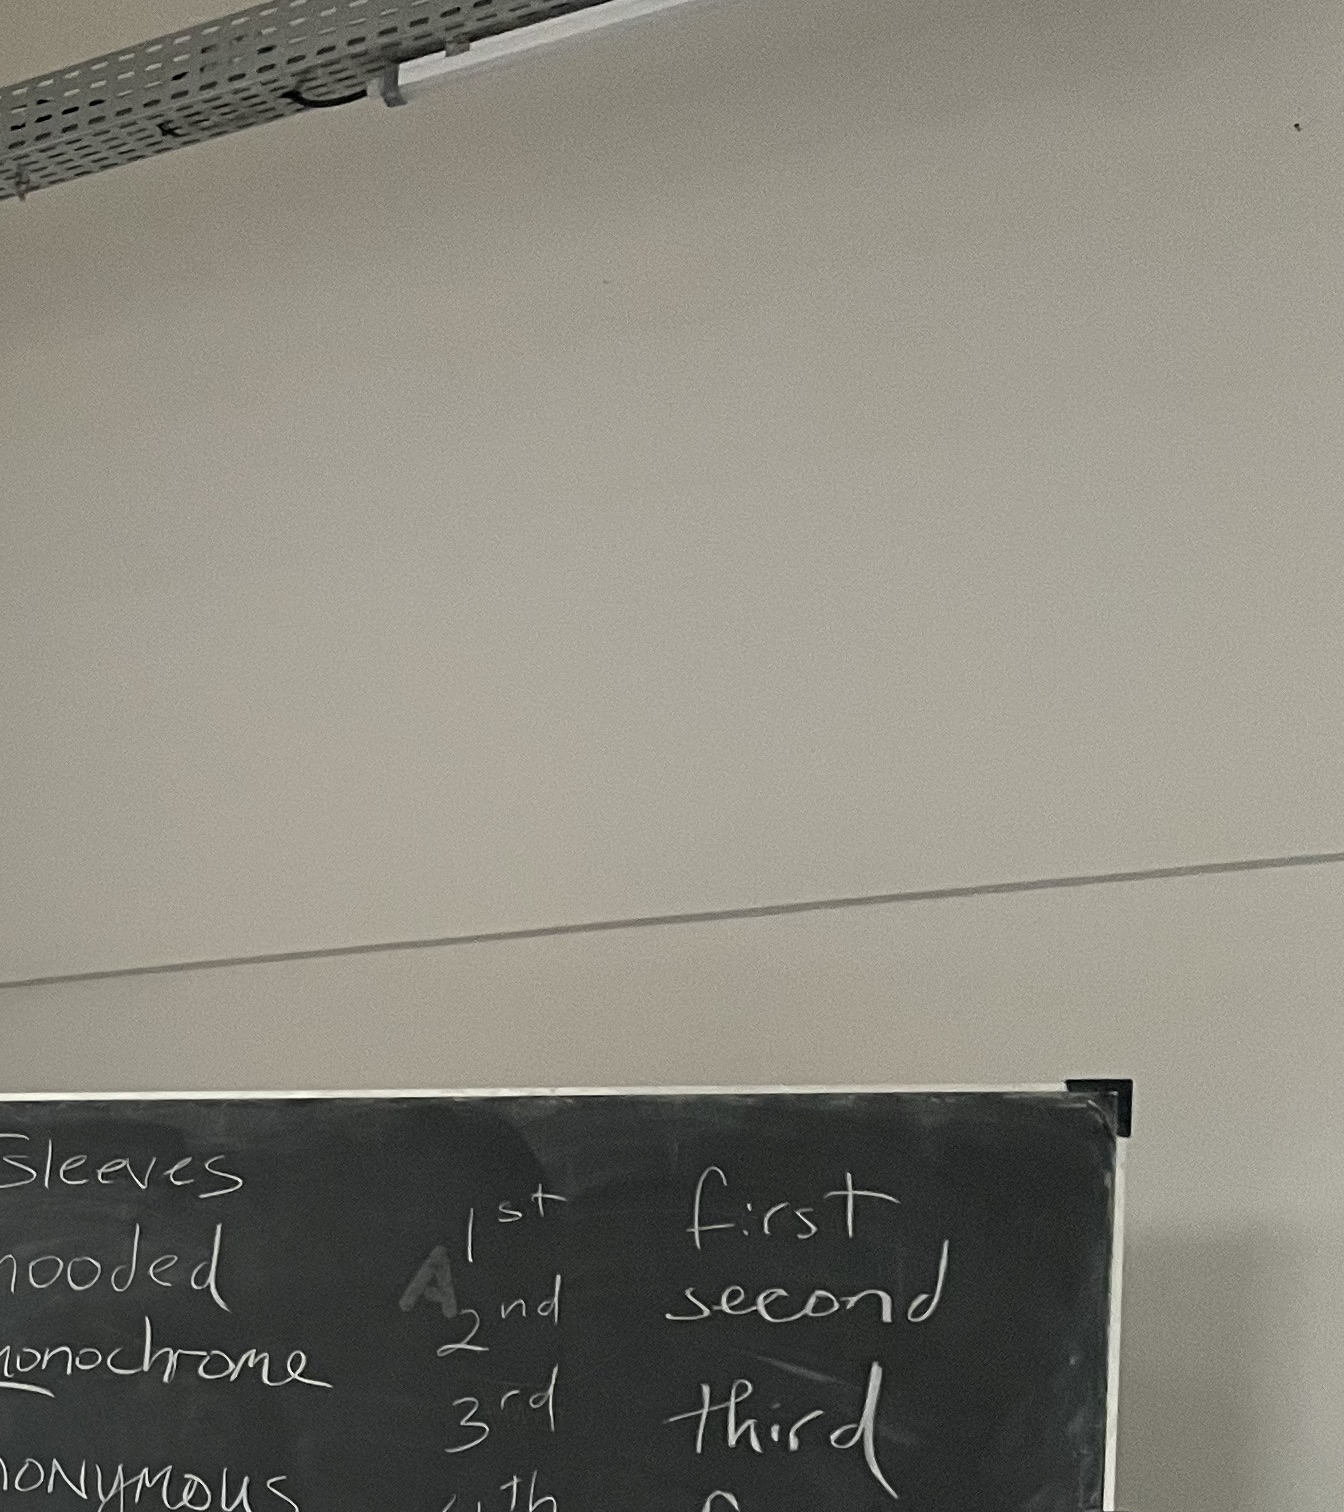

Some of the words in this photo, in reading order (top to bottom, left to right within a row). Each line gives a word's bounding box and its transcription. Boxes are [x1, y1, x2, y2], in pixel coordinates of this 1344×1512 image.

[685, 1165, 902, 1250] first
[665, 1239, 950, 1323] second
[663, 1360, 899, 1499] third
